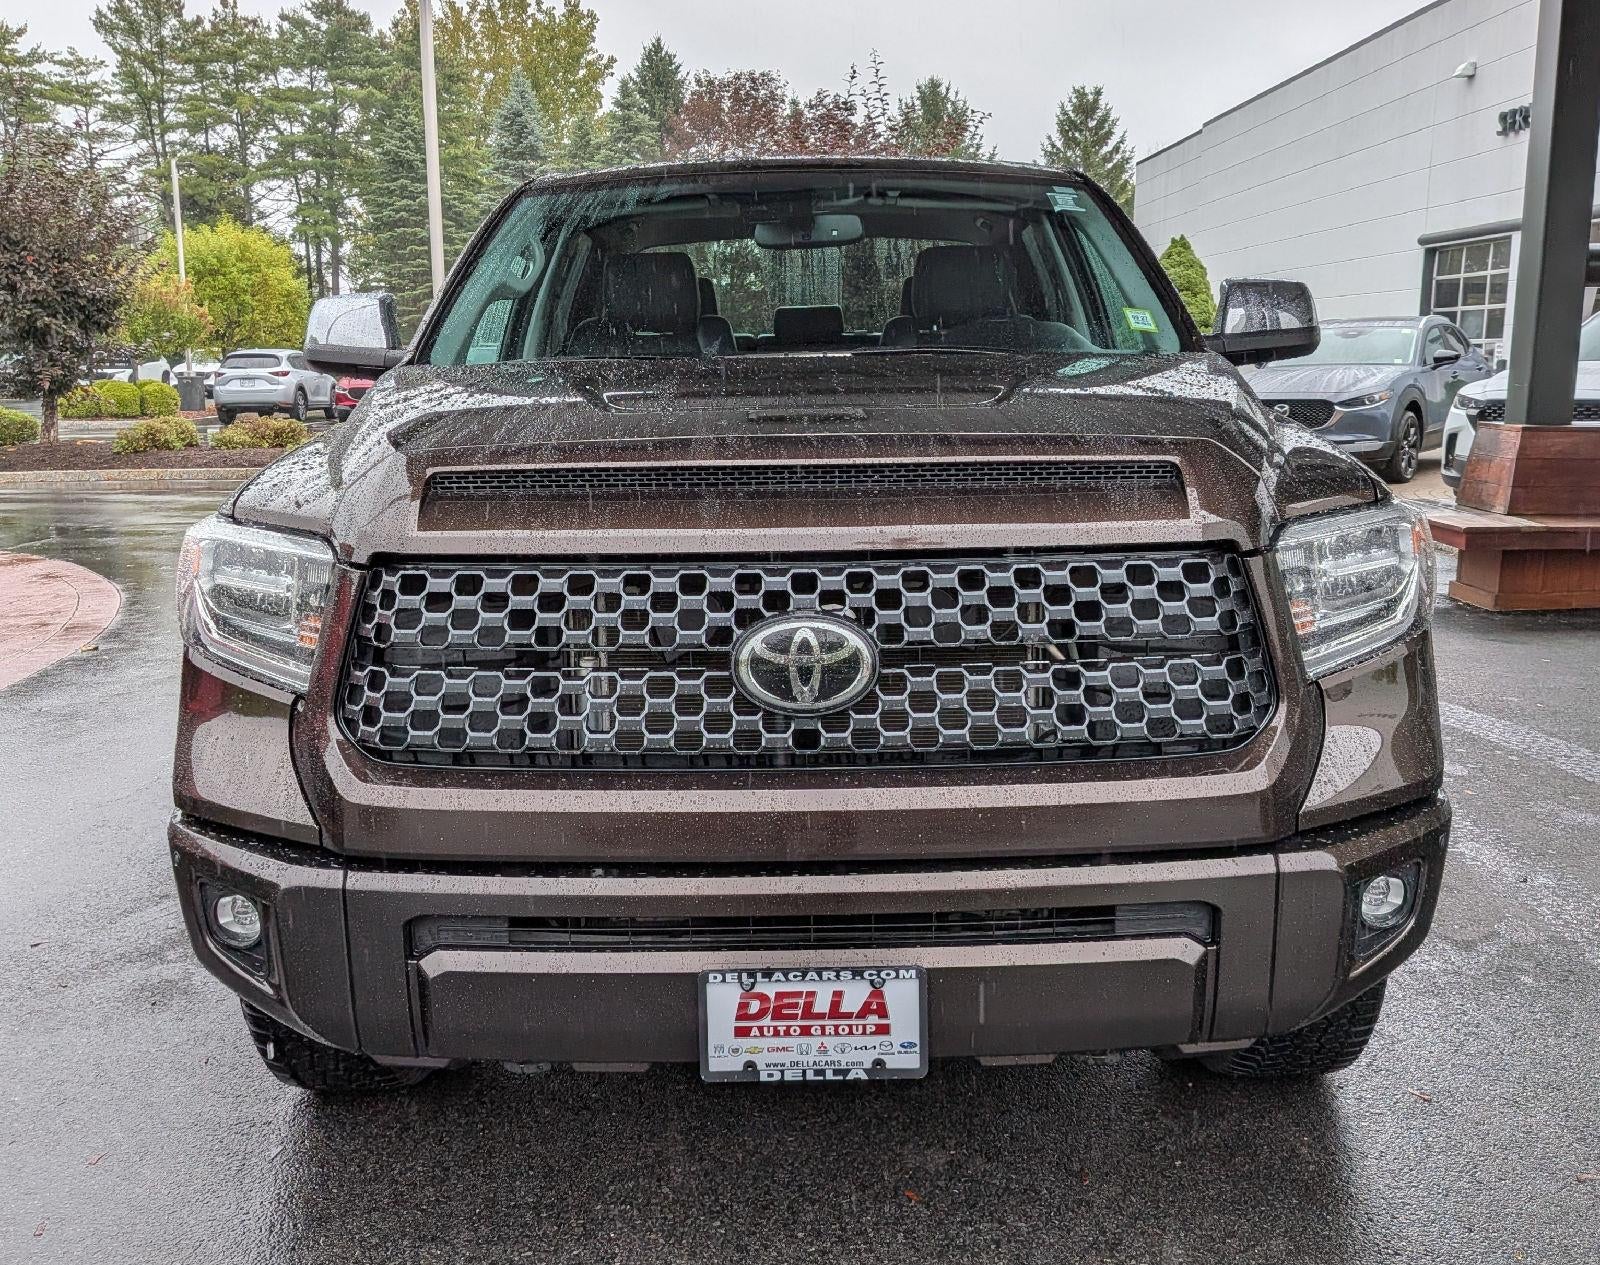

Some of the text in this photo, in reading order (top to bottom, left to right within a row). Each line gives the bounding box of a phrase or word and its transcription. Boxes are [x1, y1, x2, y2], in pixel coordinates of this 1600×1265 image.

[1496, 103, 1532, 136] SER
[708, 969, 917, 983] DELLACARS.COM
[734, 989, 891, 1022] DELLA
[749, 1024, 876, 1037] AUTO GROUP
[766, 1046, 795, 1054] GMC
[764, 1059, 865, 1069] www.DELLACARS.com
[759, 1068, 870, 1081] DELLA
